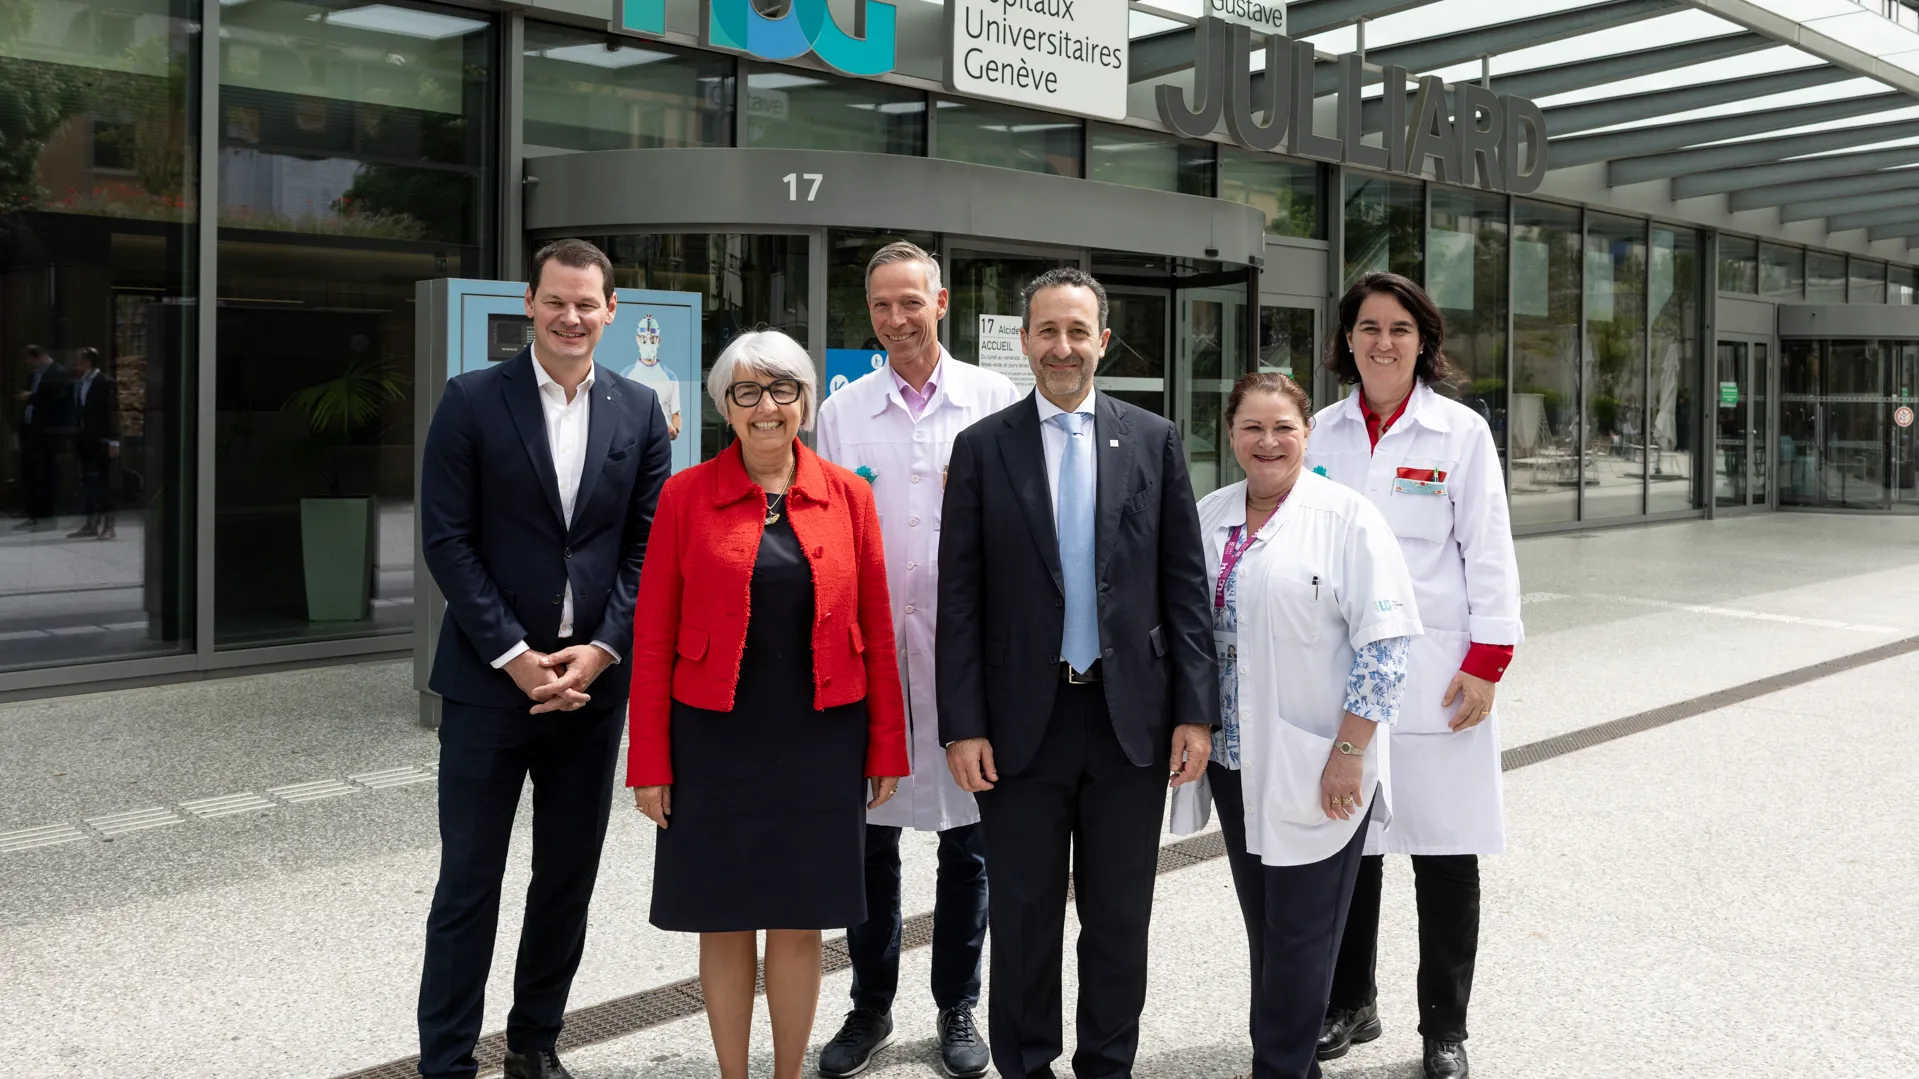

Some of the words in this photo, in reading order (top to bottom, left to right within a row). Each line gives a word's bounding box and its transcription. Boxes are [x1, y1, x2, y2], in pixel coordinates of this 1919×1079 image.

[965, 6, 1122, 69] Universitaires
[964, 47, 1058, 94] Genève
[1155, 15, 1548, 195] JULLIARD
[782, 172, 824, 202] 17
[981, 318, 995, 334] 17
[998, 325, 1020, 334] Alcide
[981, 340, 1014, 352] ACCUEIL
